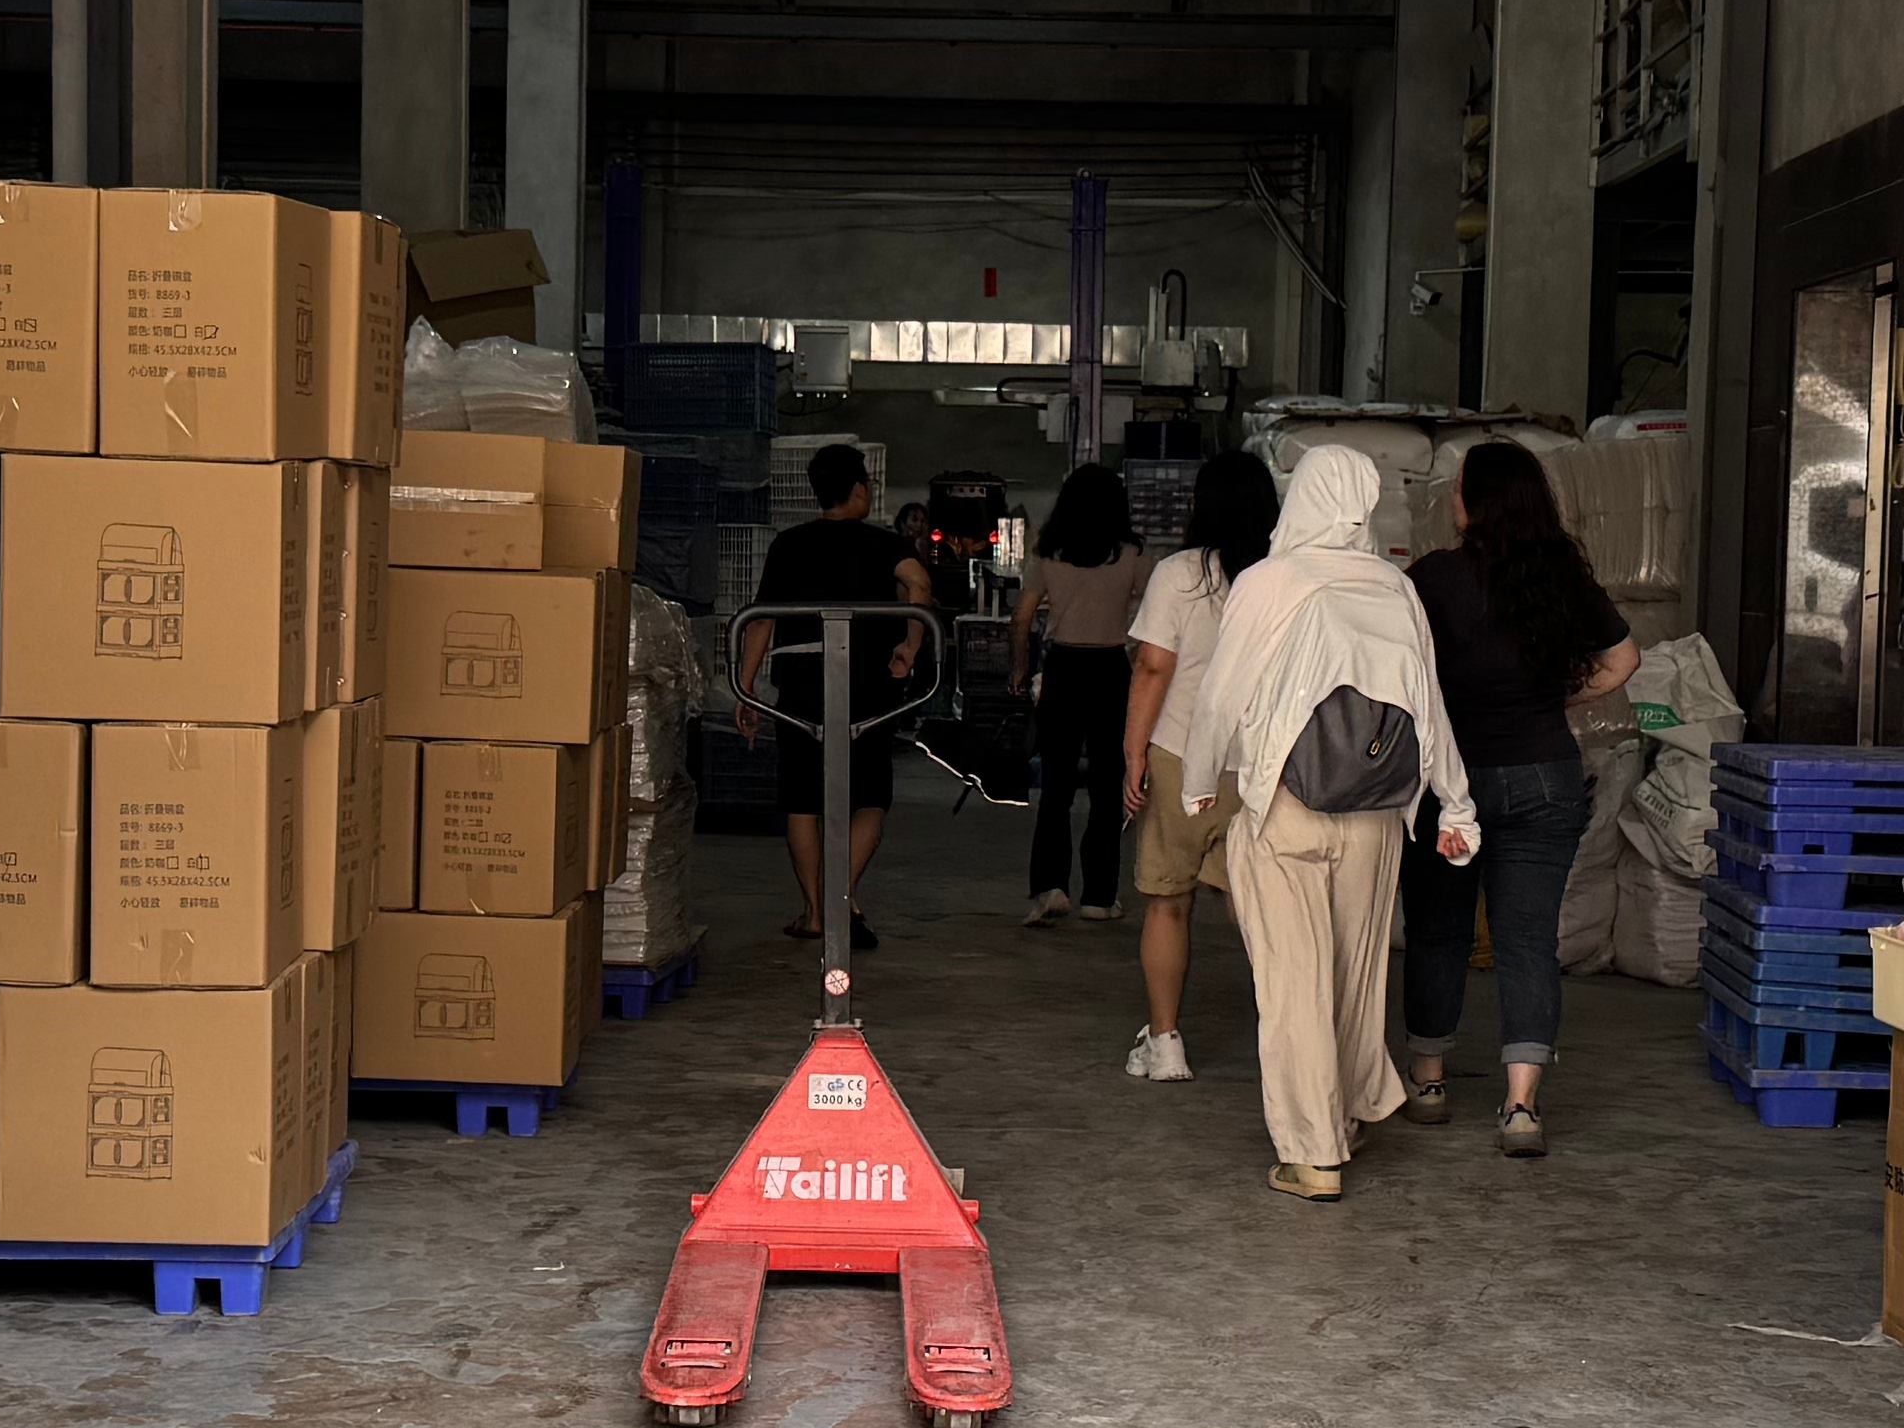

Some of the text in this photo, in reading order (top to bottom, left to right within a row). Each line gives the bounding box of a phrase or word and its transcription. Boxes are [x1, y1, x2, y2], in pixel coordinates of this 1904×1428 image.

[814, 1094, 863, 1107] 3000 kg
[758, 1156, 908, 1201] Tailift
